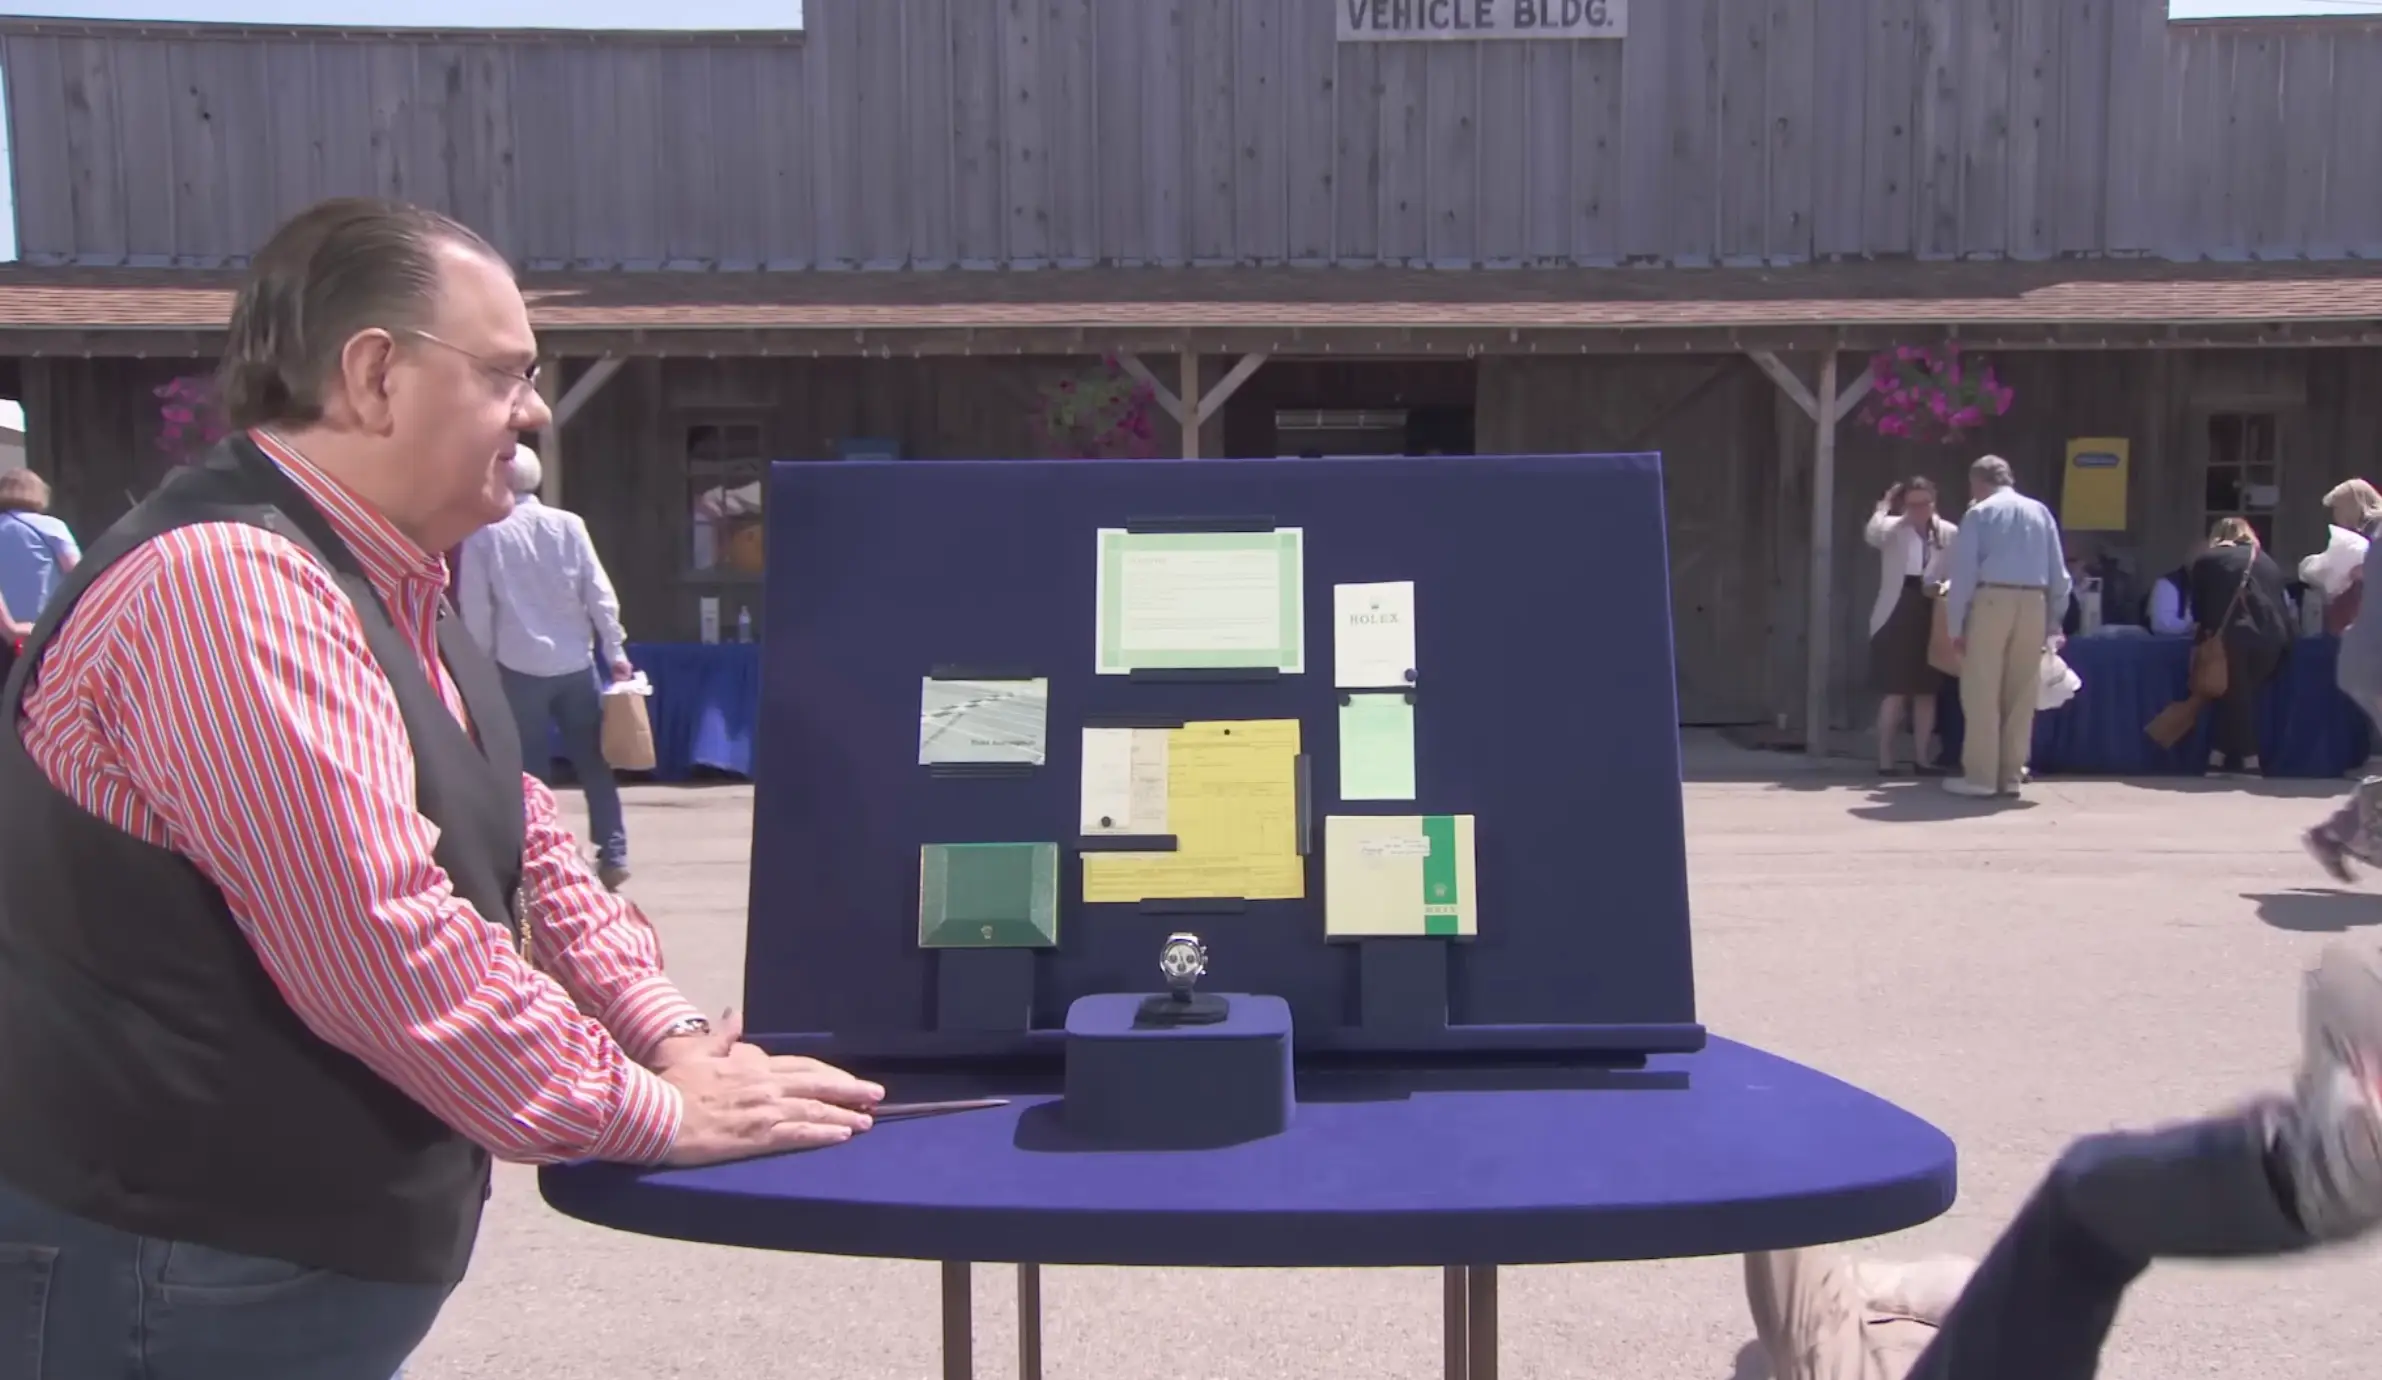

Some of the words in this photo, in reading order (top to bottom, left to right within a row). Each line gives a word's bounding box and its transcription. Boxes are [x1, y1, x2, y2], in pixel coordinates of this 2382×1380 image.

[1348, 0, 1495, 30] VEHICLE
[1514, 0, 1614, 29] BLDG.
[1350, 613, 1399, 626] ROLEX
